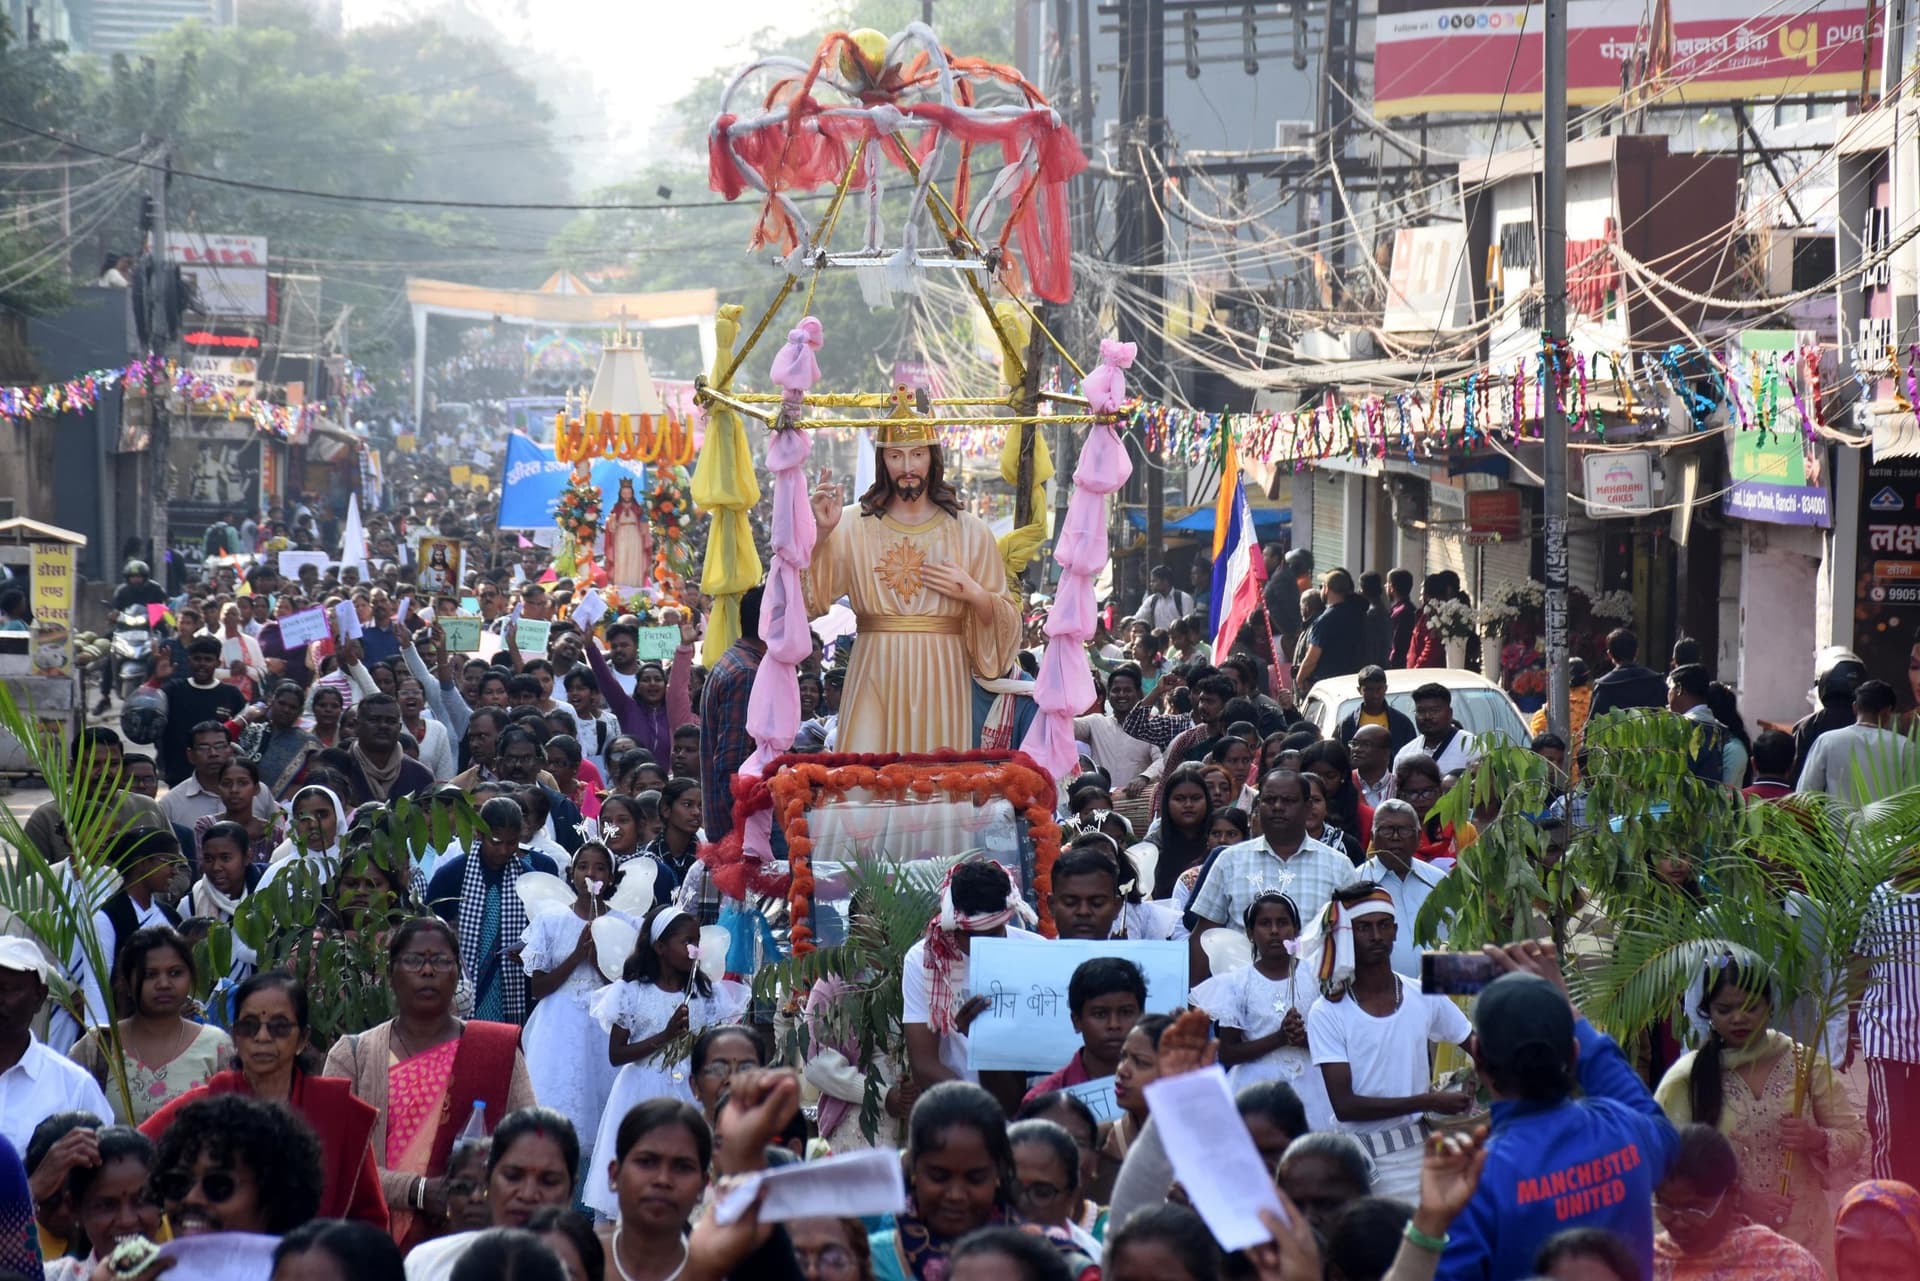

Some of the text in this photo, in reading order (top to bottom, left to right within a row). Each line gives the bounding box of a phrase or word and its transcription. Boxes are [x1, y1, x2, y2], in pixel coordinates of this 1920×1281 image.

[1596, 483, 1644, 496] MAHARANI
[1608, 493, 1634, 503] CAKES
[1776, 492, 1797, 513] Ranchi
[1802, 495, 1827, 515] 834001
[1518, 1144, 1640, 1204] MANCHESTER
[1555, 1179, 1626, 1221] UNITED
